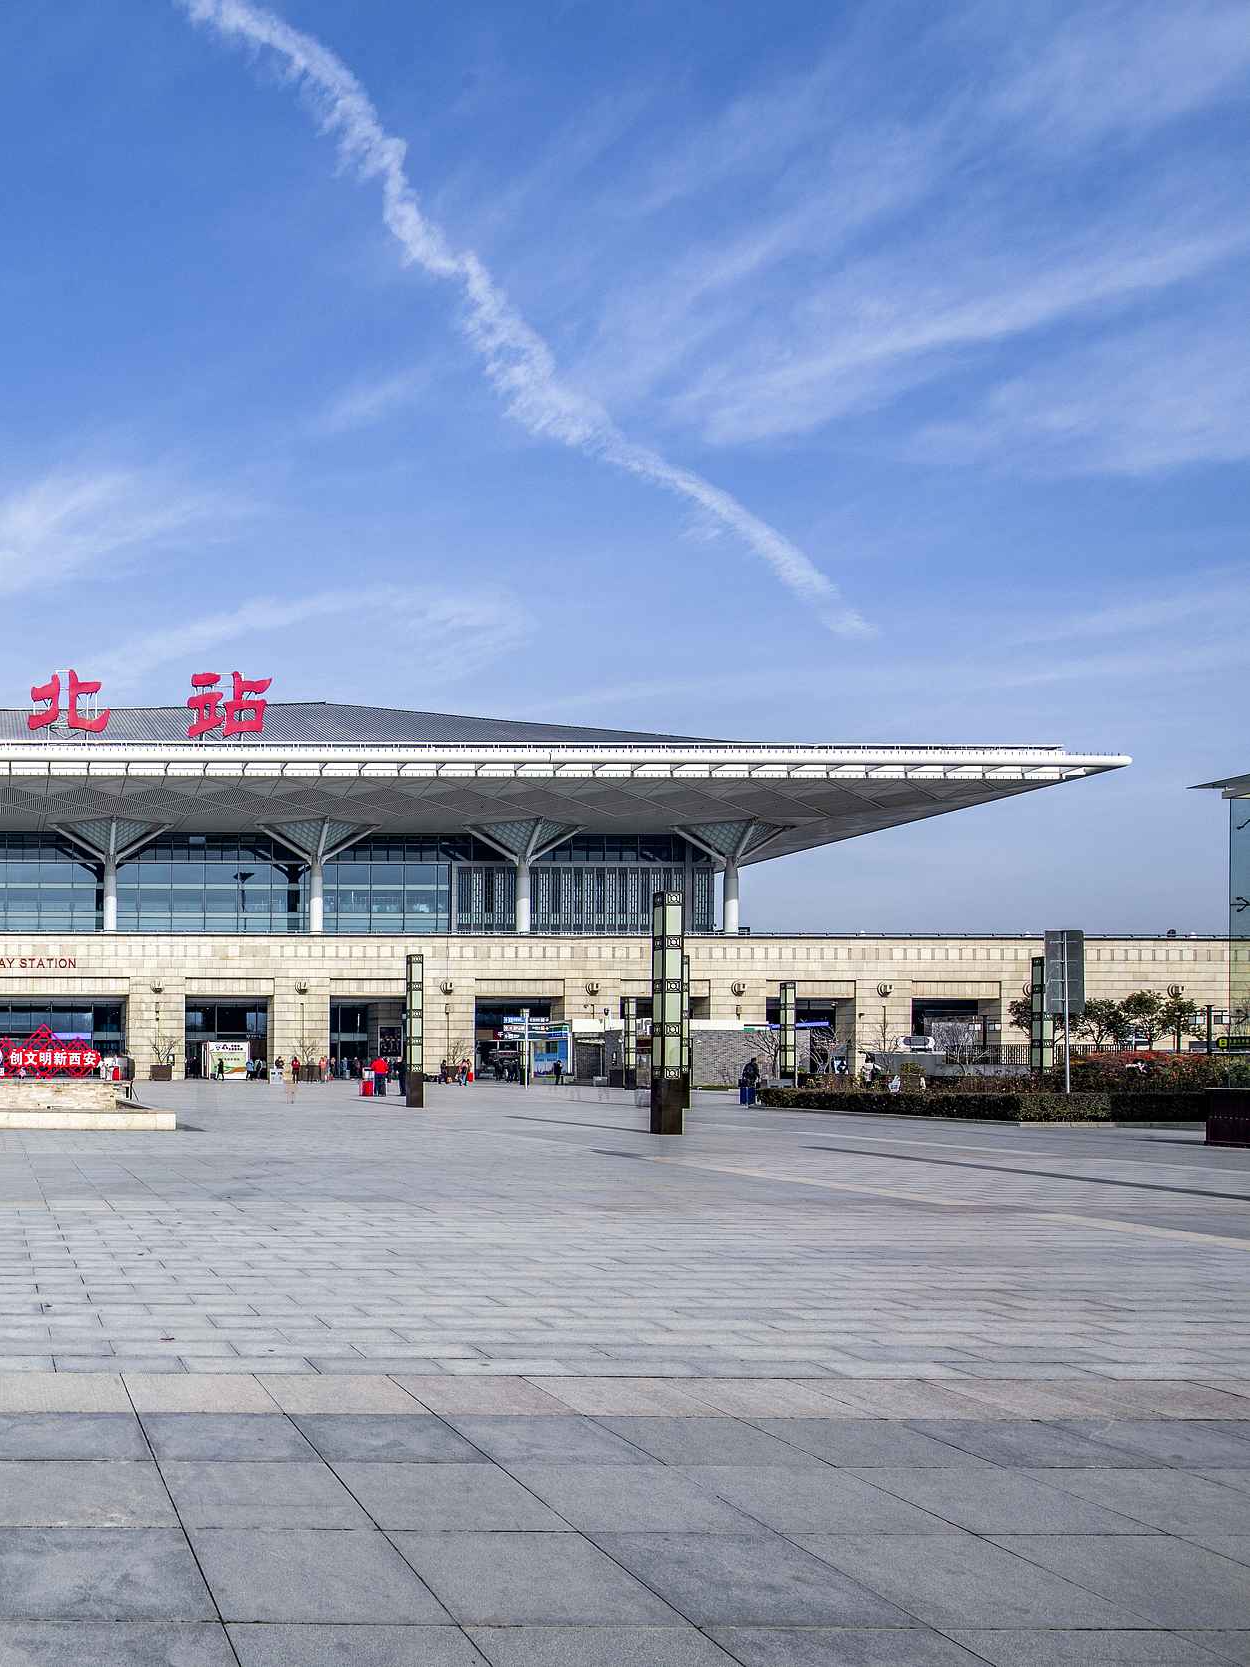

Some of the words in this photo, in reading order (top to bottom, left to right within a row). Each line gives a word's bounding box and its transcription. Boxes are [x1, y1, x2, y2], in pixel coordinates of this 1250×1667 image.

[19, 957, 76, 968] STATION
[9, 1051, 96, 1066] 创文明新西安
